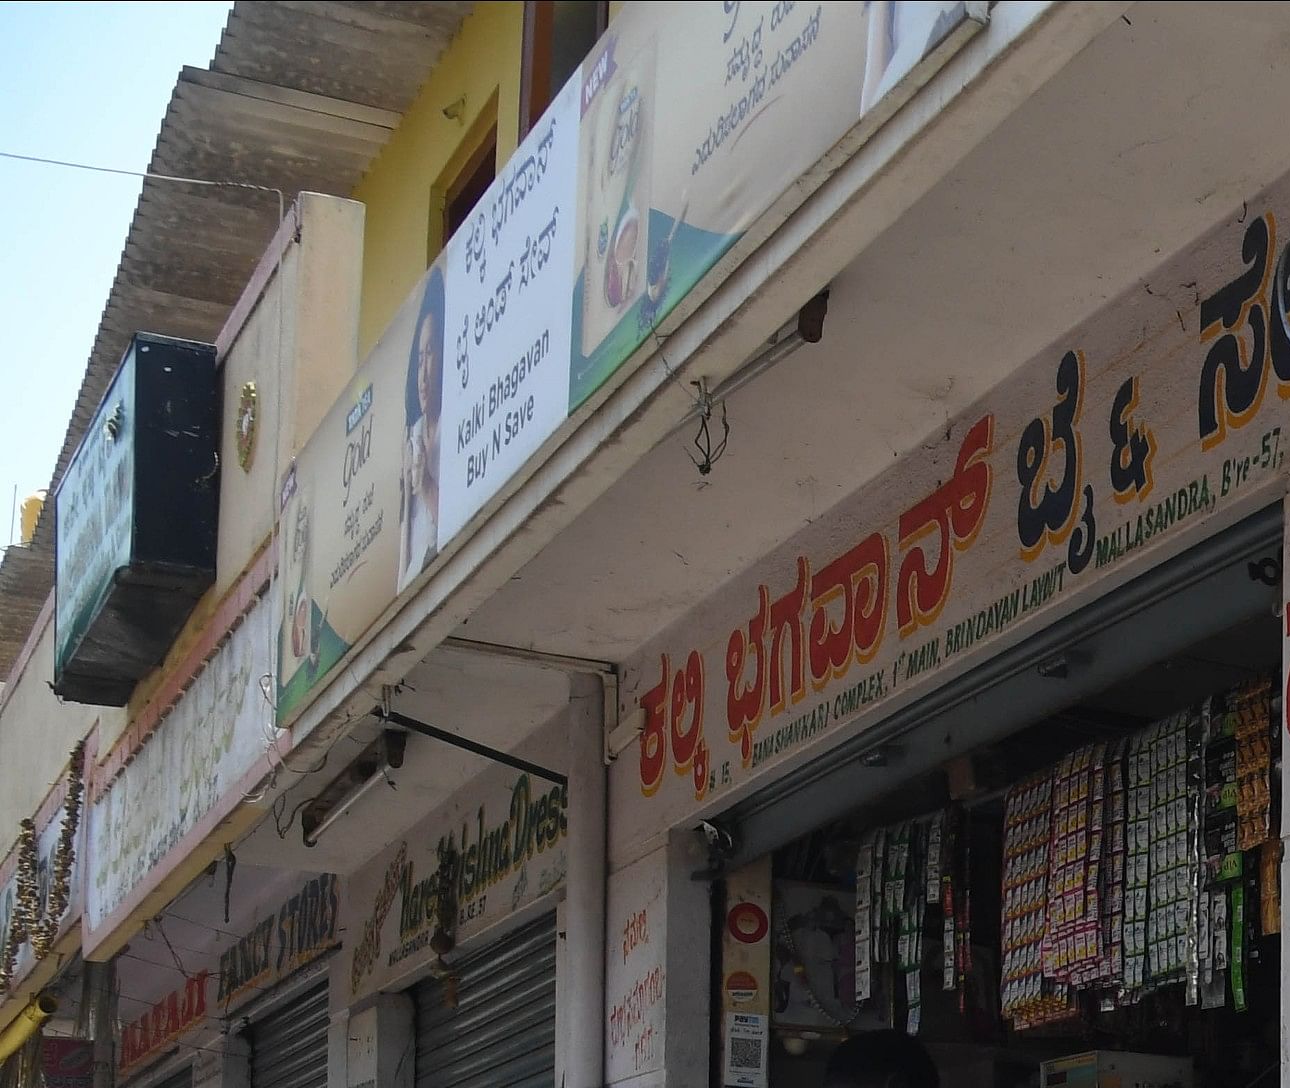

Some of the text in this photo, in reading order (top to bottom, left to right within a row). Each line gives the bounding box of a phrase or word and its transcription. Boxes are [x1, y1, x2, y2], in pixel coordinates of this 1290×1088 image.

[457, 329, 549, 454] Kalki Bhagavan
[467, 395, 534, 489] Buy N Save
